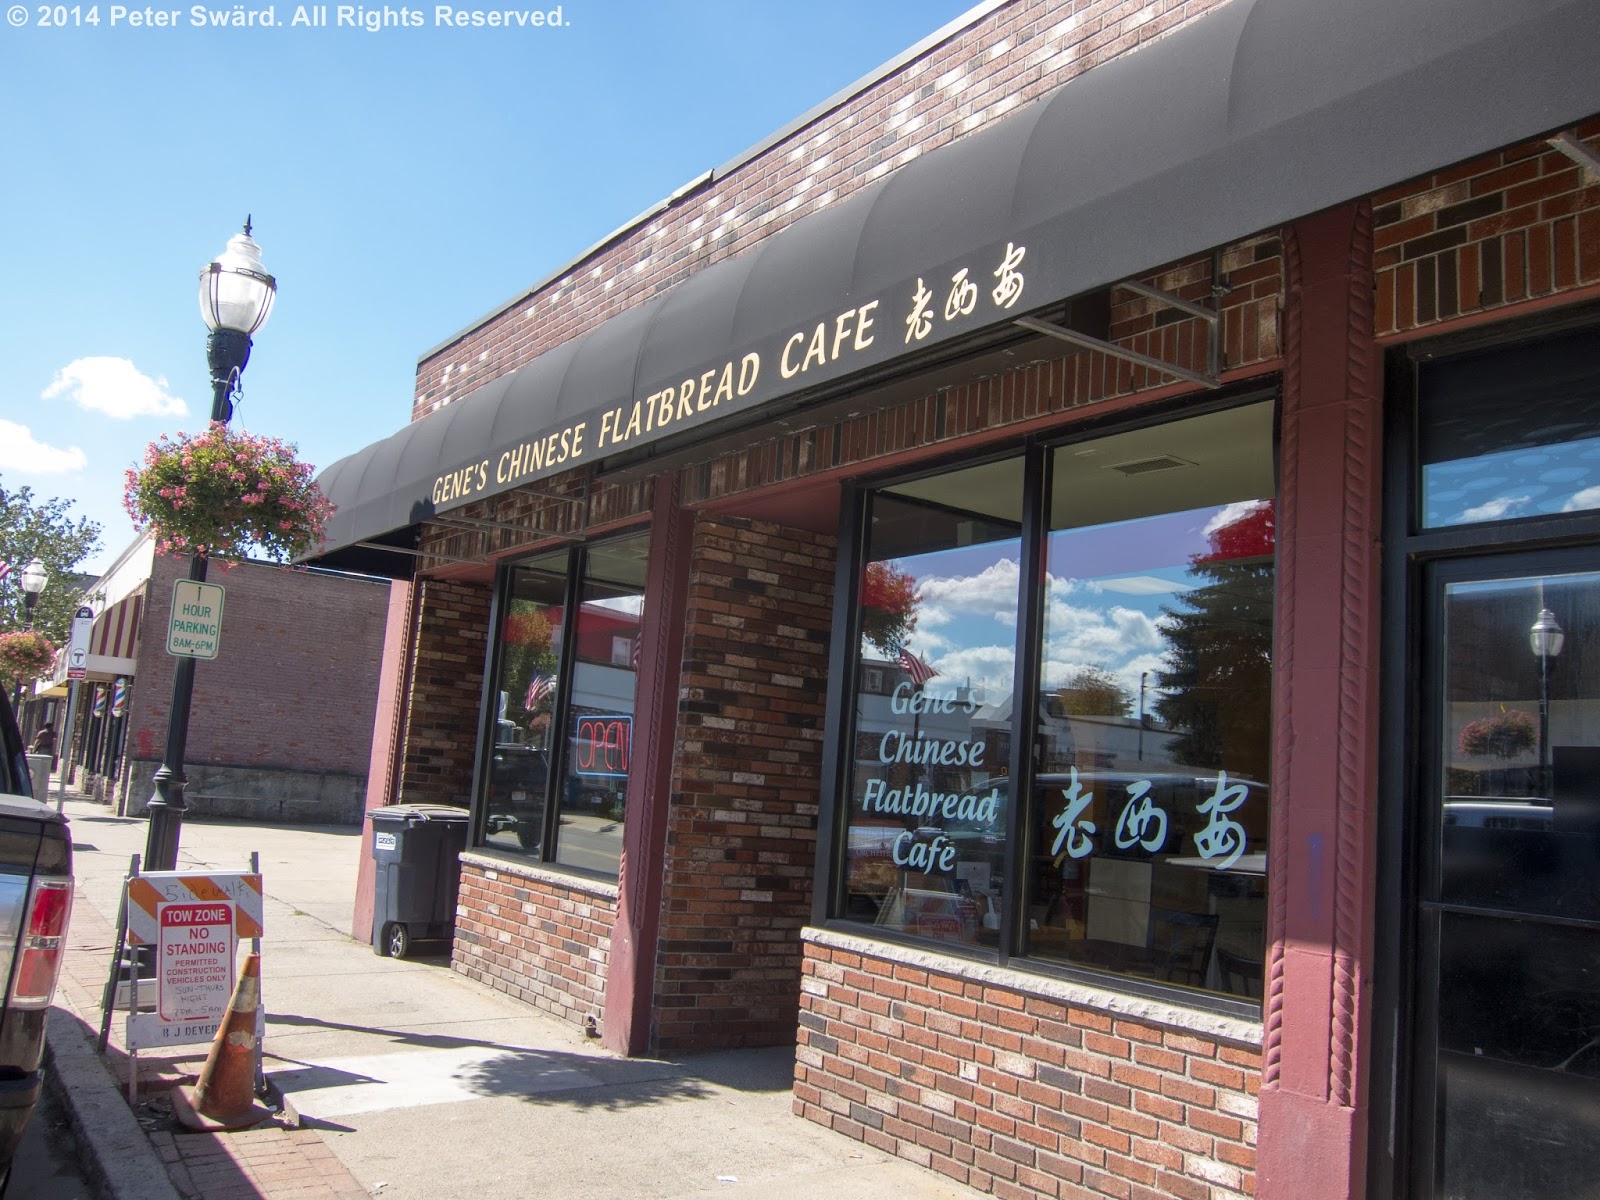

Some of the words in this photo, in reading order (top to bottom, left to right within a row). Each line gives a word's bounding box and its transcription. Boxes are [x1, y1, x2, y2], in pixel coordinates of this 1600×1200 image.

[432, 460, 489, 505] GENE'S
[497, 422, 585, 484] CHINESE
[598, 352, 760, 448] FLATBREAD
[780, 300, 879, 379] CAFE
[183, 603, 212, 618] HOUR
[173, 619, 217, 636] PARKING
[173, 637, 213, 651] 8AM-6PM
[73, 652, 84, 664] T
[578, 721, 630, 771] OPEN
[879, 730, 986, 767] Chinese
[862, 779, 999, 823] Flatbread
[166, 909, 193, 923] TOW
[195, 908, 226, 922] ZONE
[189, 927, 209, 939] NO
[166, 942, 226, 956] STANDING
[175, 958, 218, 967] PERMITTED
[166, 966, 226, 976] CONSTRUCTION
[167, 975, 205, 984] VEHICLES
[206, 974, 226, 982] ONLY
